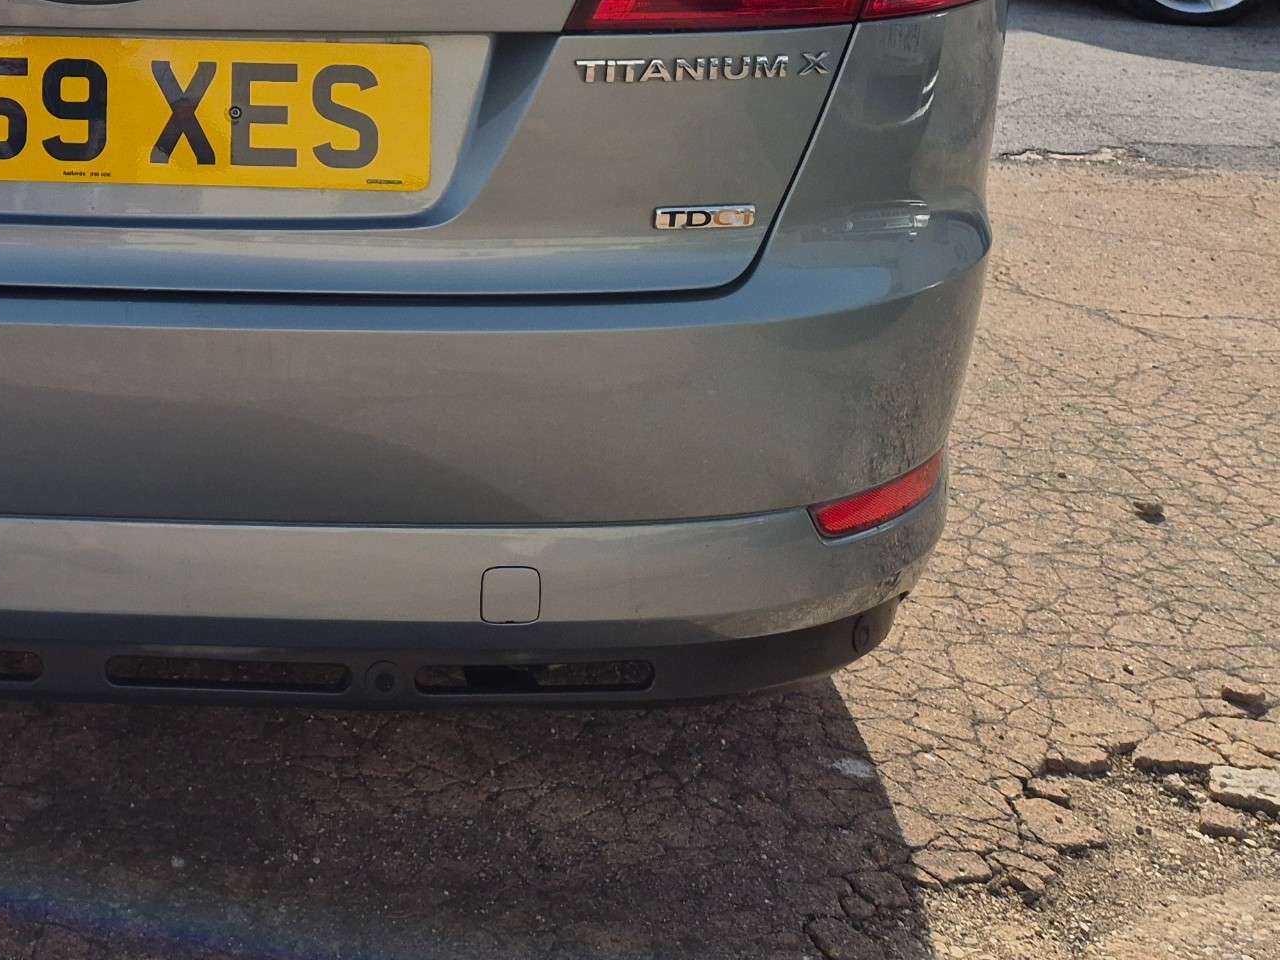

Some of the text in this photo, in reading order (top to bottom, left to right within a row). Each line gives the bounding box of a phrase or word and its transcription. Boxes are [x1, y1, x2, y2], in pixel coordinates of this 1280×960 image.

[575, 51, 831, 82] TITANIUM X
[149, 60, 380, 170] XES
